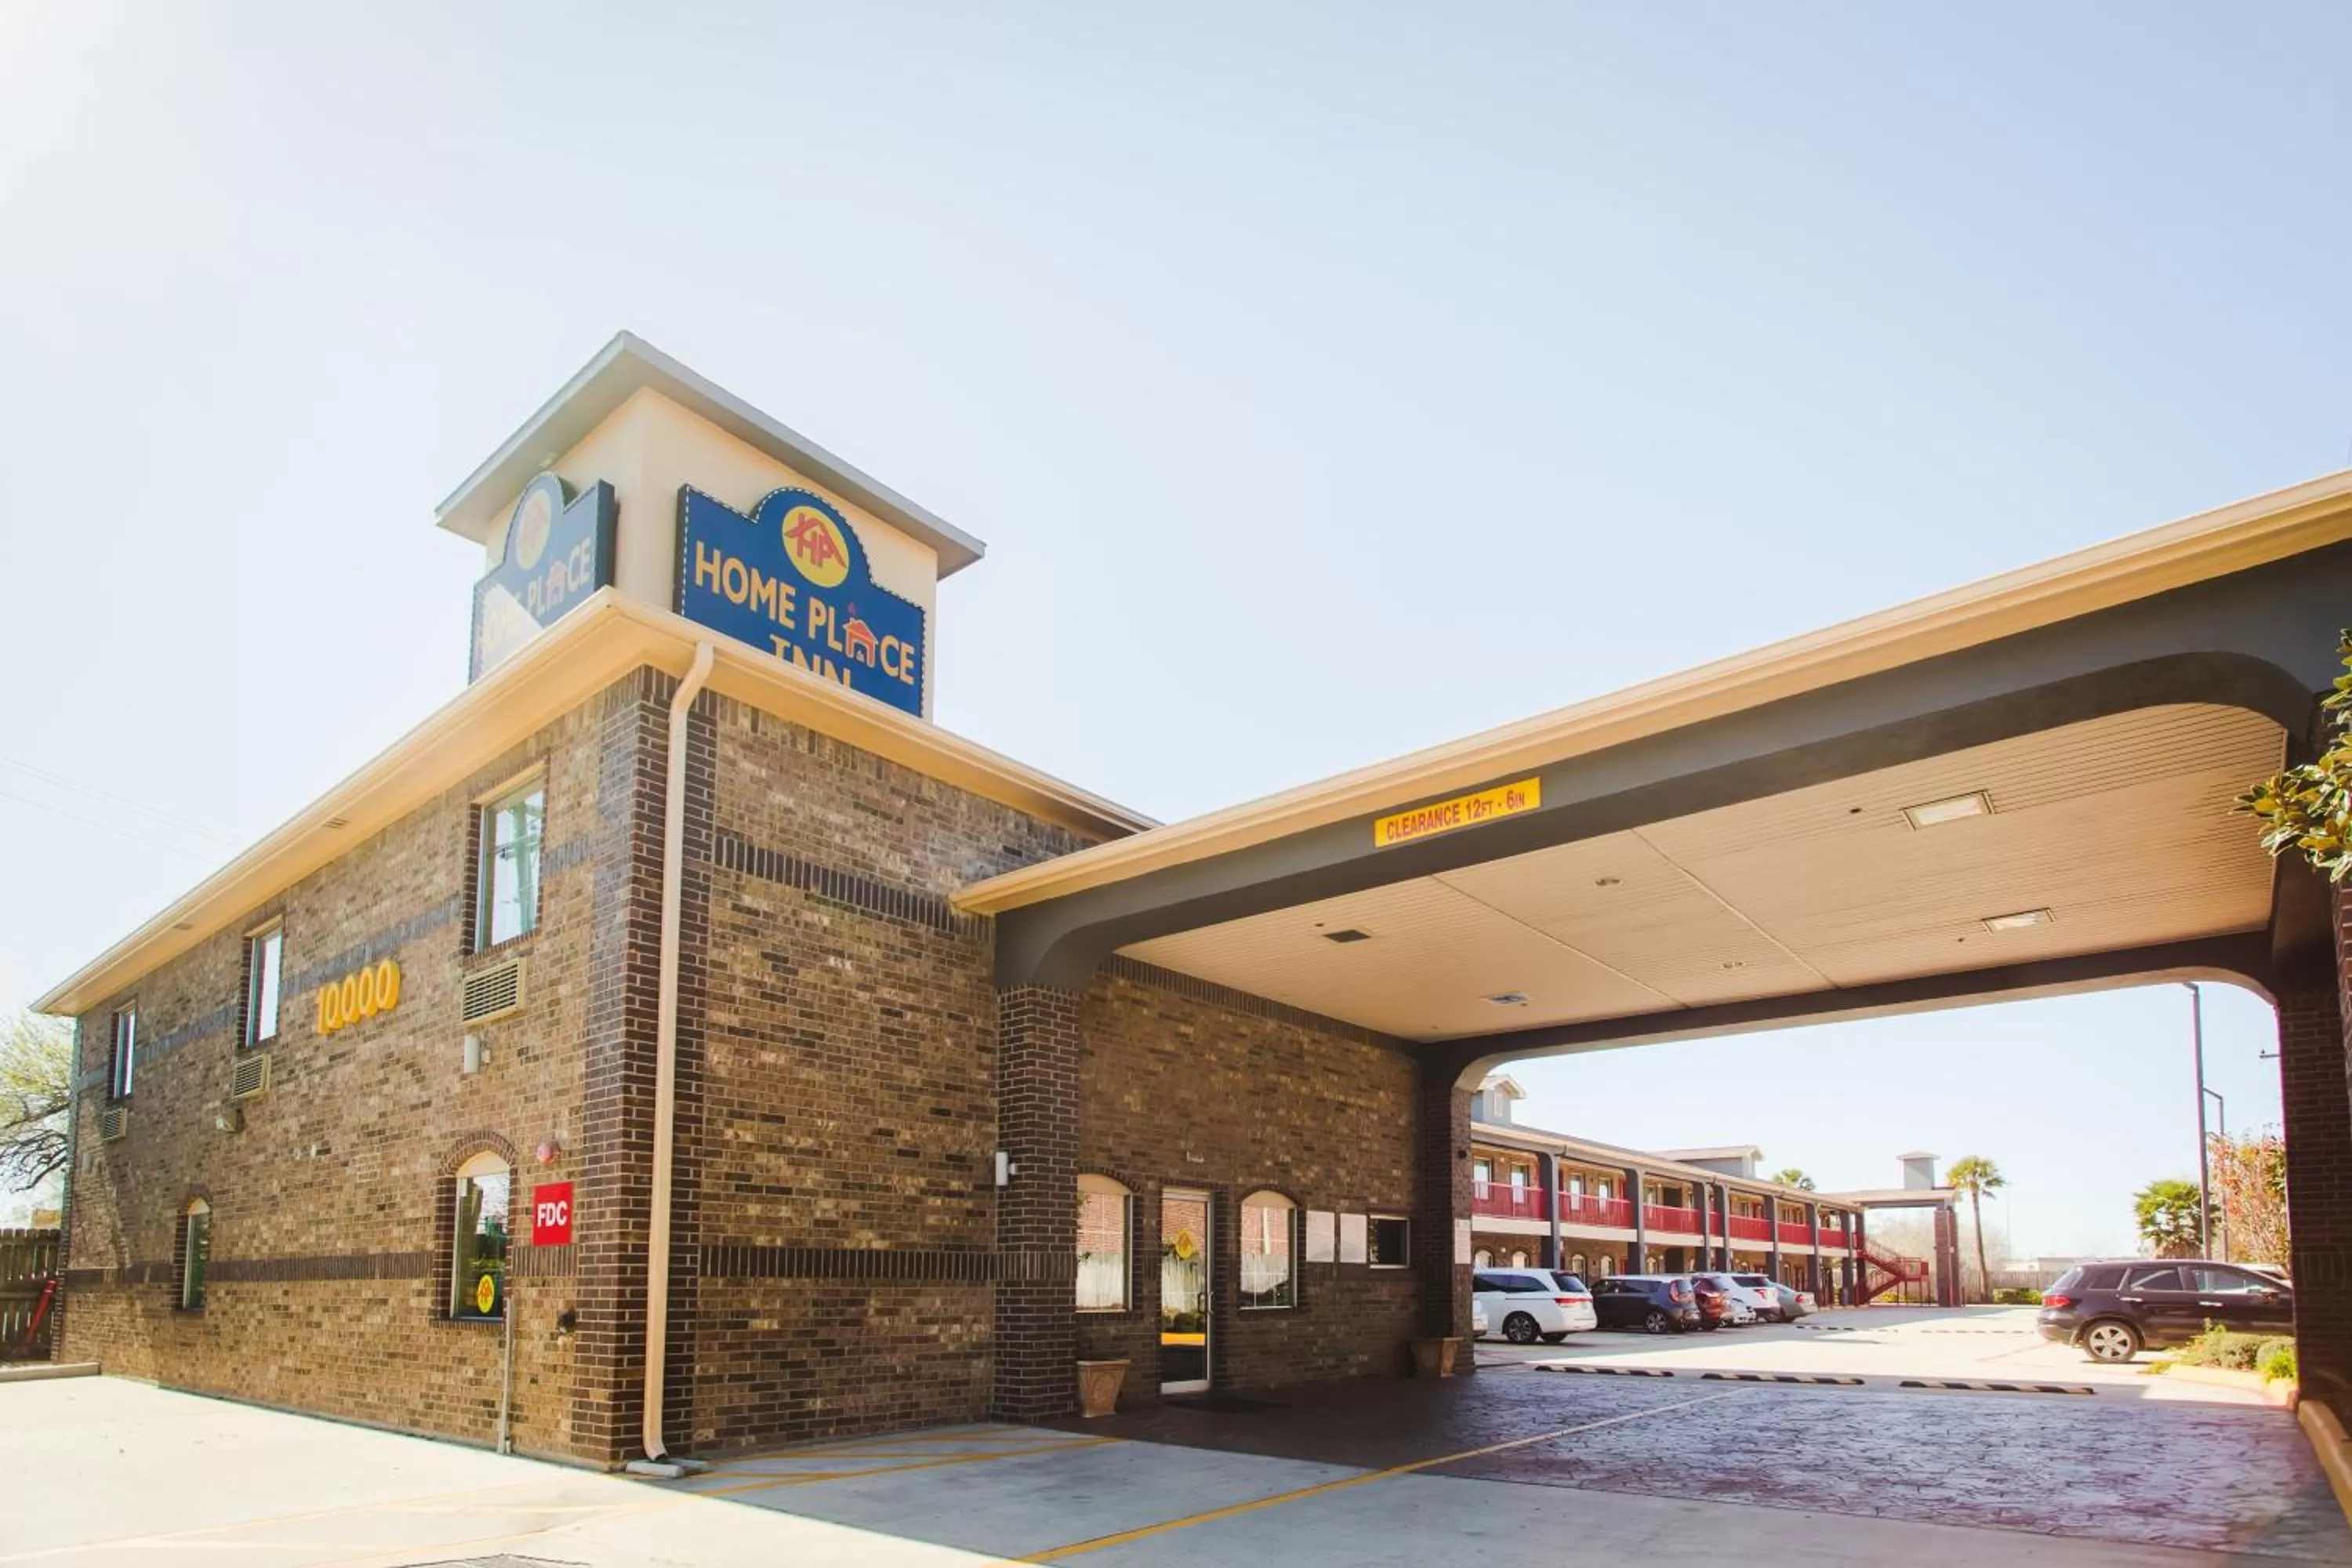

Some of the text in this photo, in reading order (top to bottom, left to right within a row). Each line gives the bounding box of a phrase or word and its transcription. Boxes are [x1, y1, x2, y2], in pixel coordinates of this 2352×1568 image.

[695, 539, 796, 630] HOME
[1386, 803, 1461, 841] CLEARANCE
[1465, 798, 1494, 821] 12FT
[316, 957, 401, 1034] 10000
[536, 1200, 568, 1228] FDC
